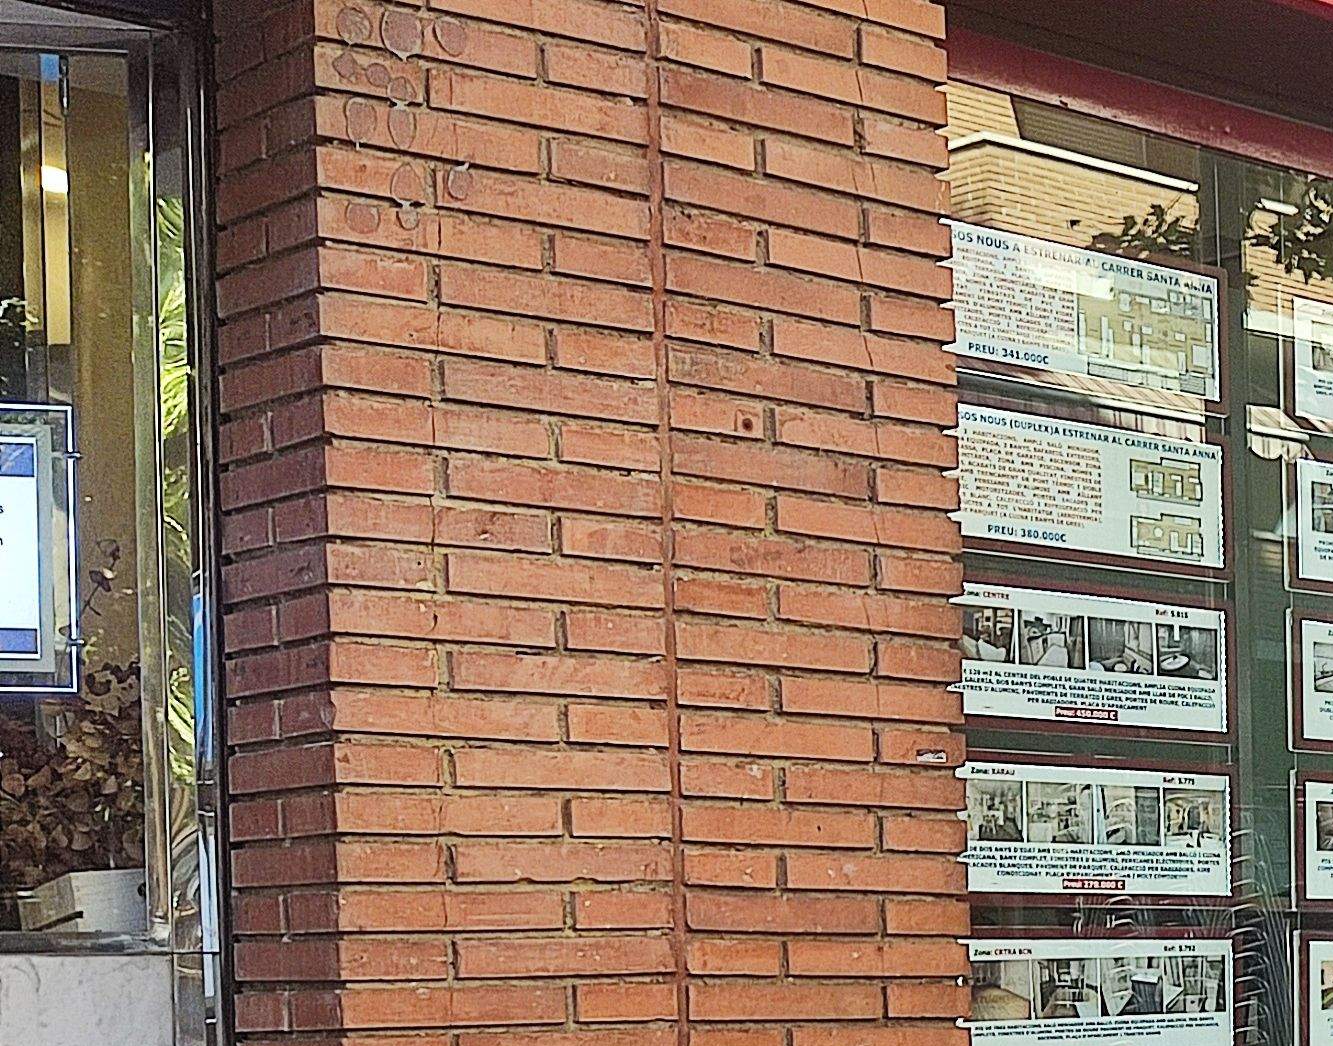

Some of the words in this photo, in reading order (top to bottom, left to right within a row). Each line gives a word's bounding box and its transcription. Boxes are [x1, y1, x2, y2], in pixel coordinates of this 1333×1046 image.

[977, 234, 1008, 250] NOUS
[1102, 261, 1143, 279] CARRER
[1146, 271, 1179, 286] SANTA
[968, 341, 998, 355] PREU:
[980, 414, 1006, 426] NOUS
[1063, 428, 1108, 442] ESTRENAR
[1111, 435, 1121, 444] AL
[1125, 437, 1158, 450] CARRER
[1162, 443, 1189, 455] SANTA
[988, 524, 1017, 536] PREU:
